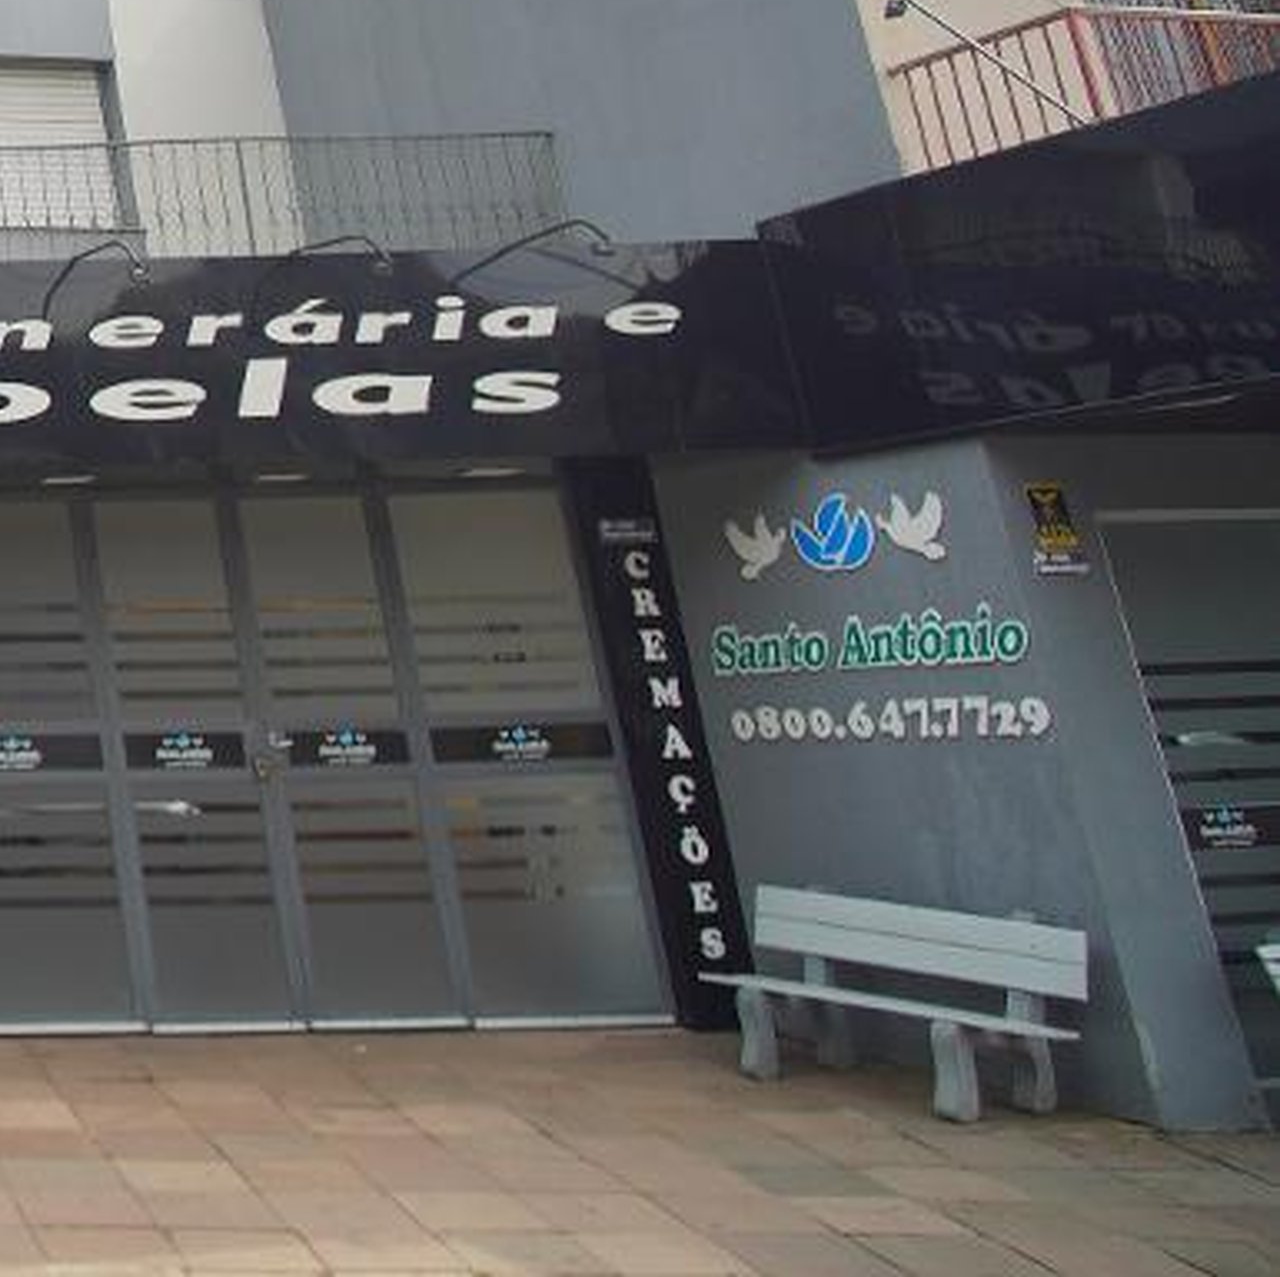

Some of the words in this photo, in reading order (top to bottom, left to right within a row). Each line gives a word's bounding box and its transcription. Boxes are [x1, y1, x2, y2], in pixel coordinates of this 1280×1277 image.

[605, 302, 681, 335] e
[711, 624, 830, 677] Santo
[839, 602, 1030, 670] Antônio
[624, 551, 727, 960] CREMAÇÕES
